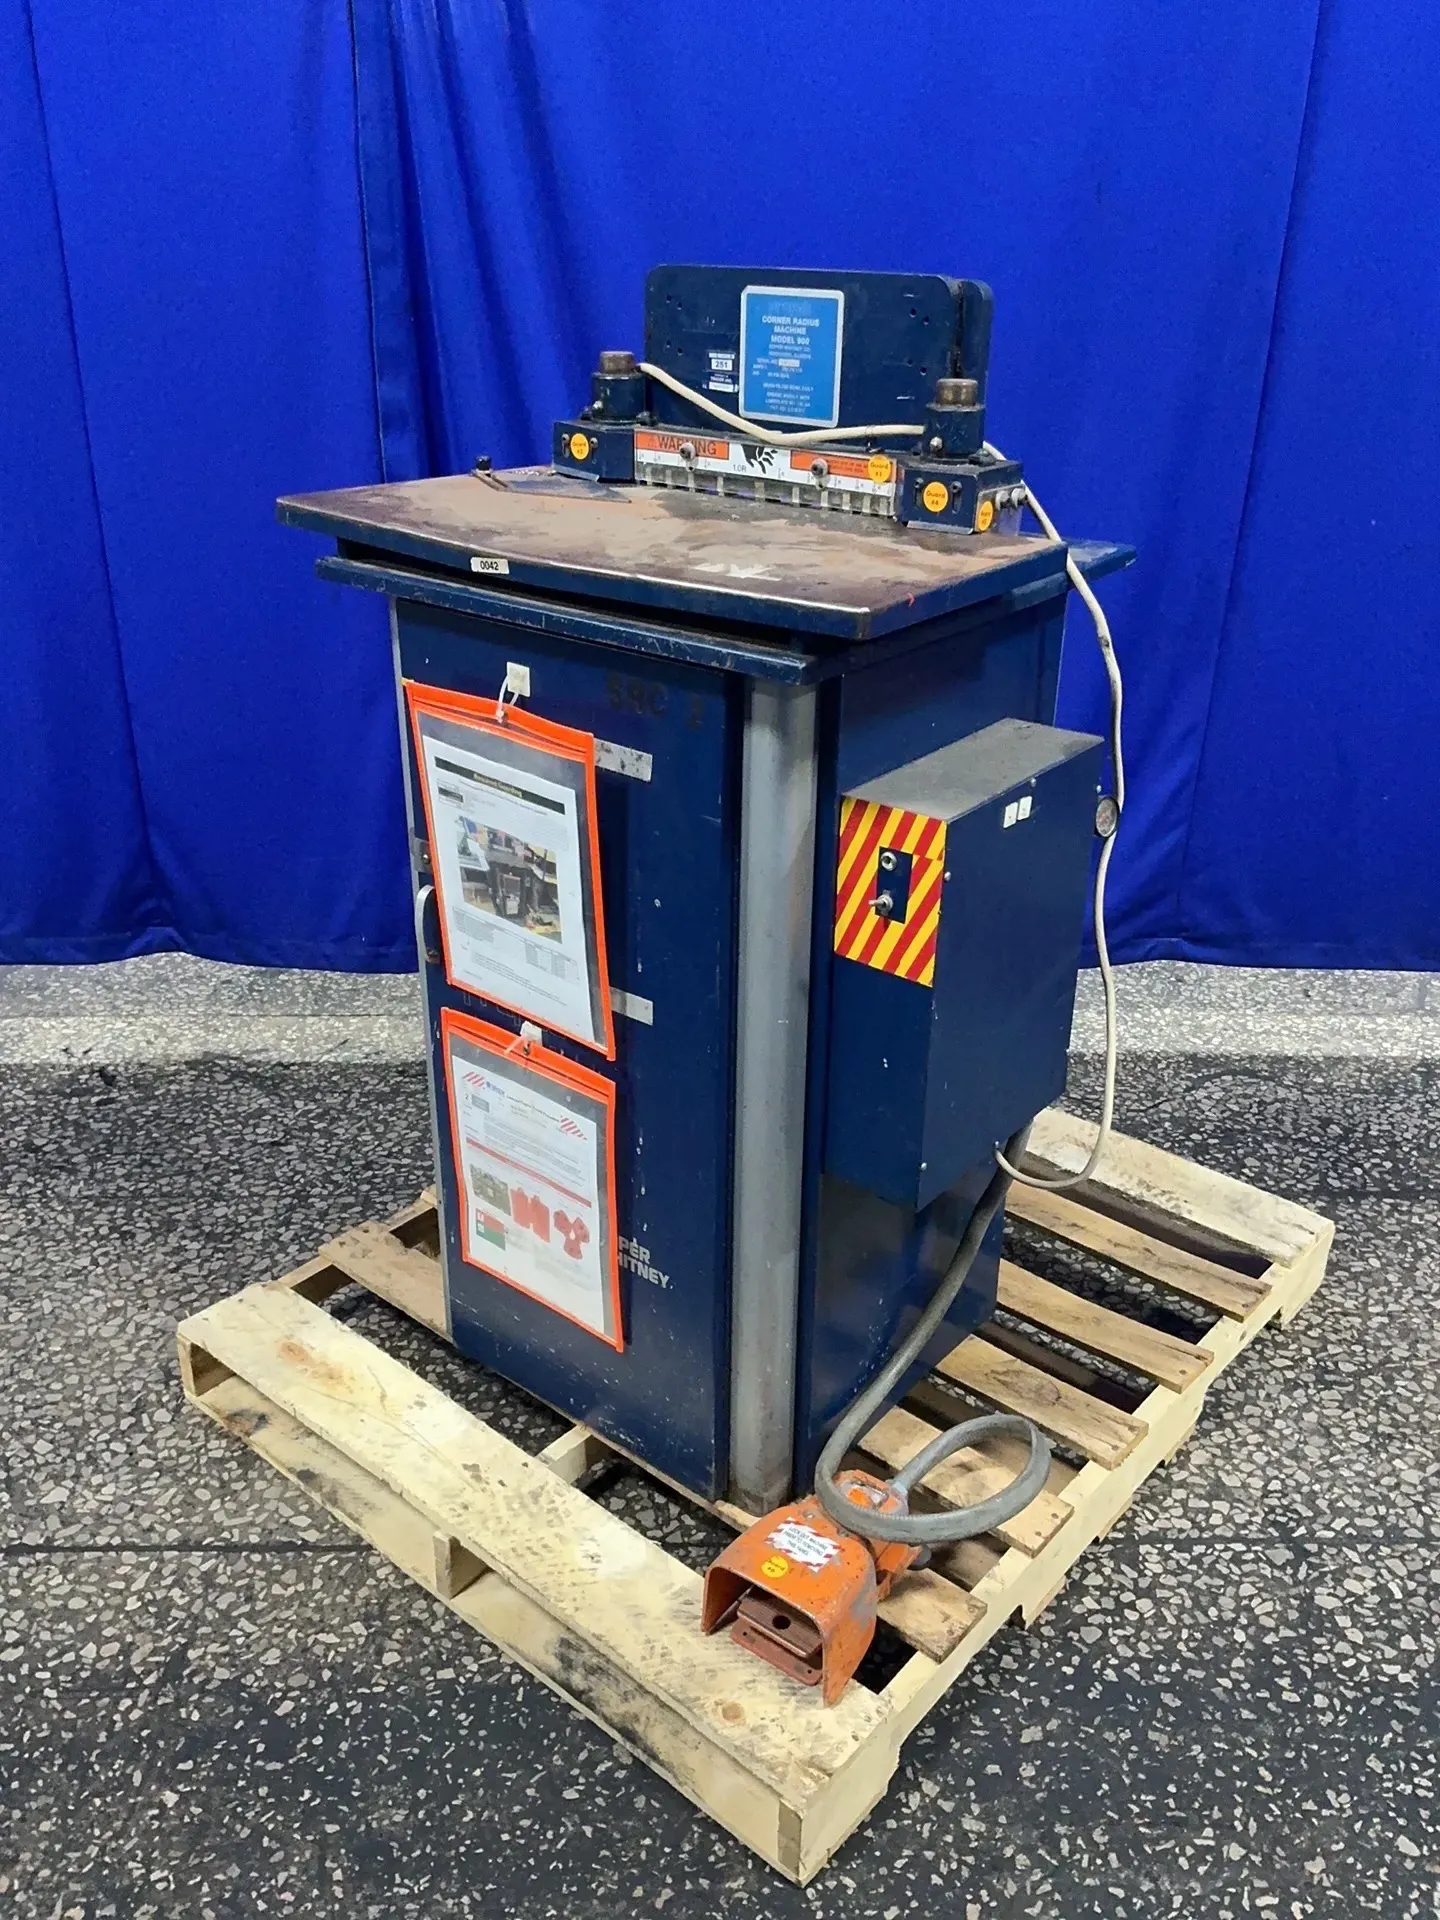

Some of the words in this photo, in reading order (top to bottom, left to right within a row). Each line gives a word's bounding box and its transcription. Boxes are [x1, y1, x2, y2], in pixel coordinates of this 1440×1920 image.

[762, 315, 791, 325] CORNER
[792, 317, 820, 327] RADIUS
[773, 325, 807, 335] MACHINE
[770, 335, 795, 344] MODEL
[714, 360, 728, 369] 251
[869, 462, 888, 470] Guard
[926, 490, 946, 499] Guard
[480, 560, 499, 571] 0042
